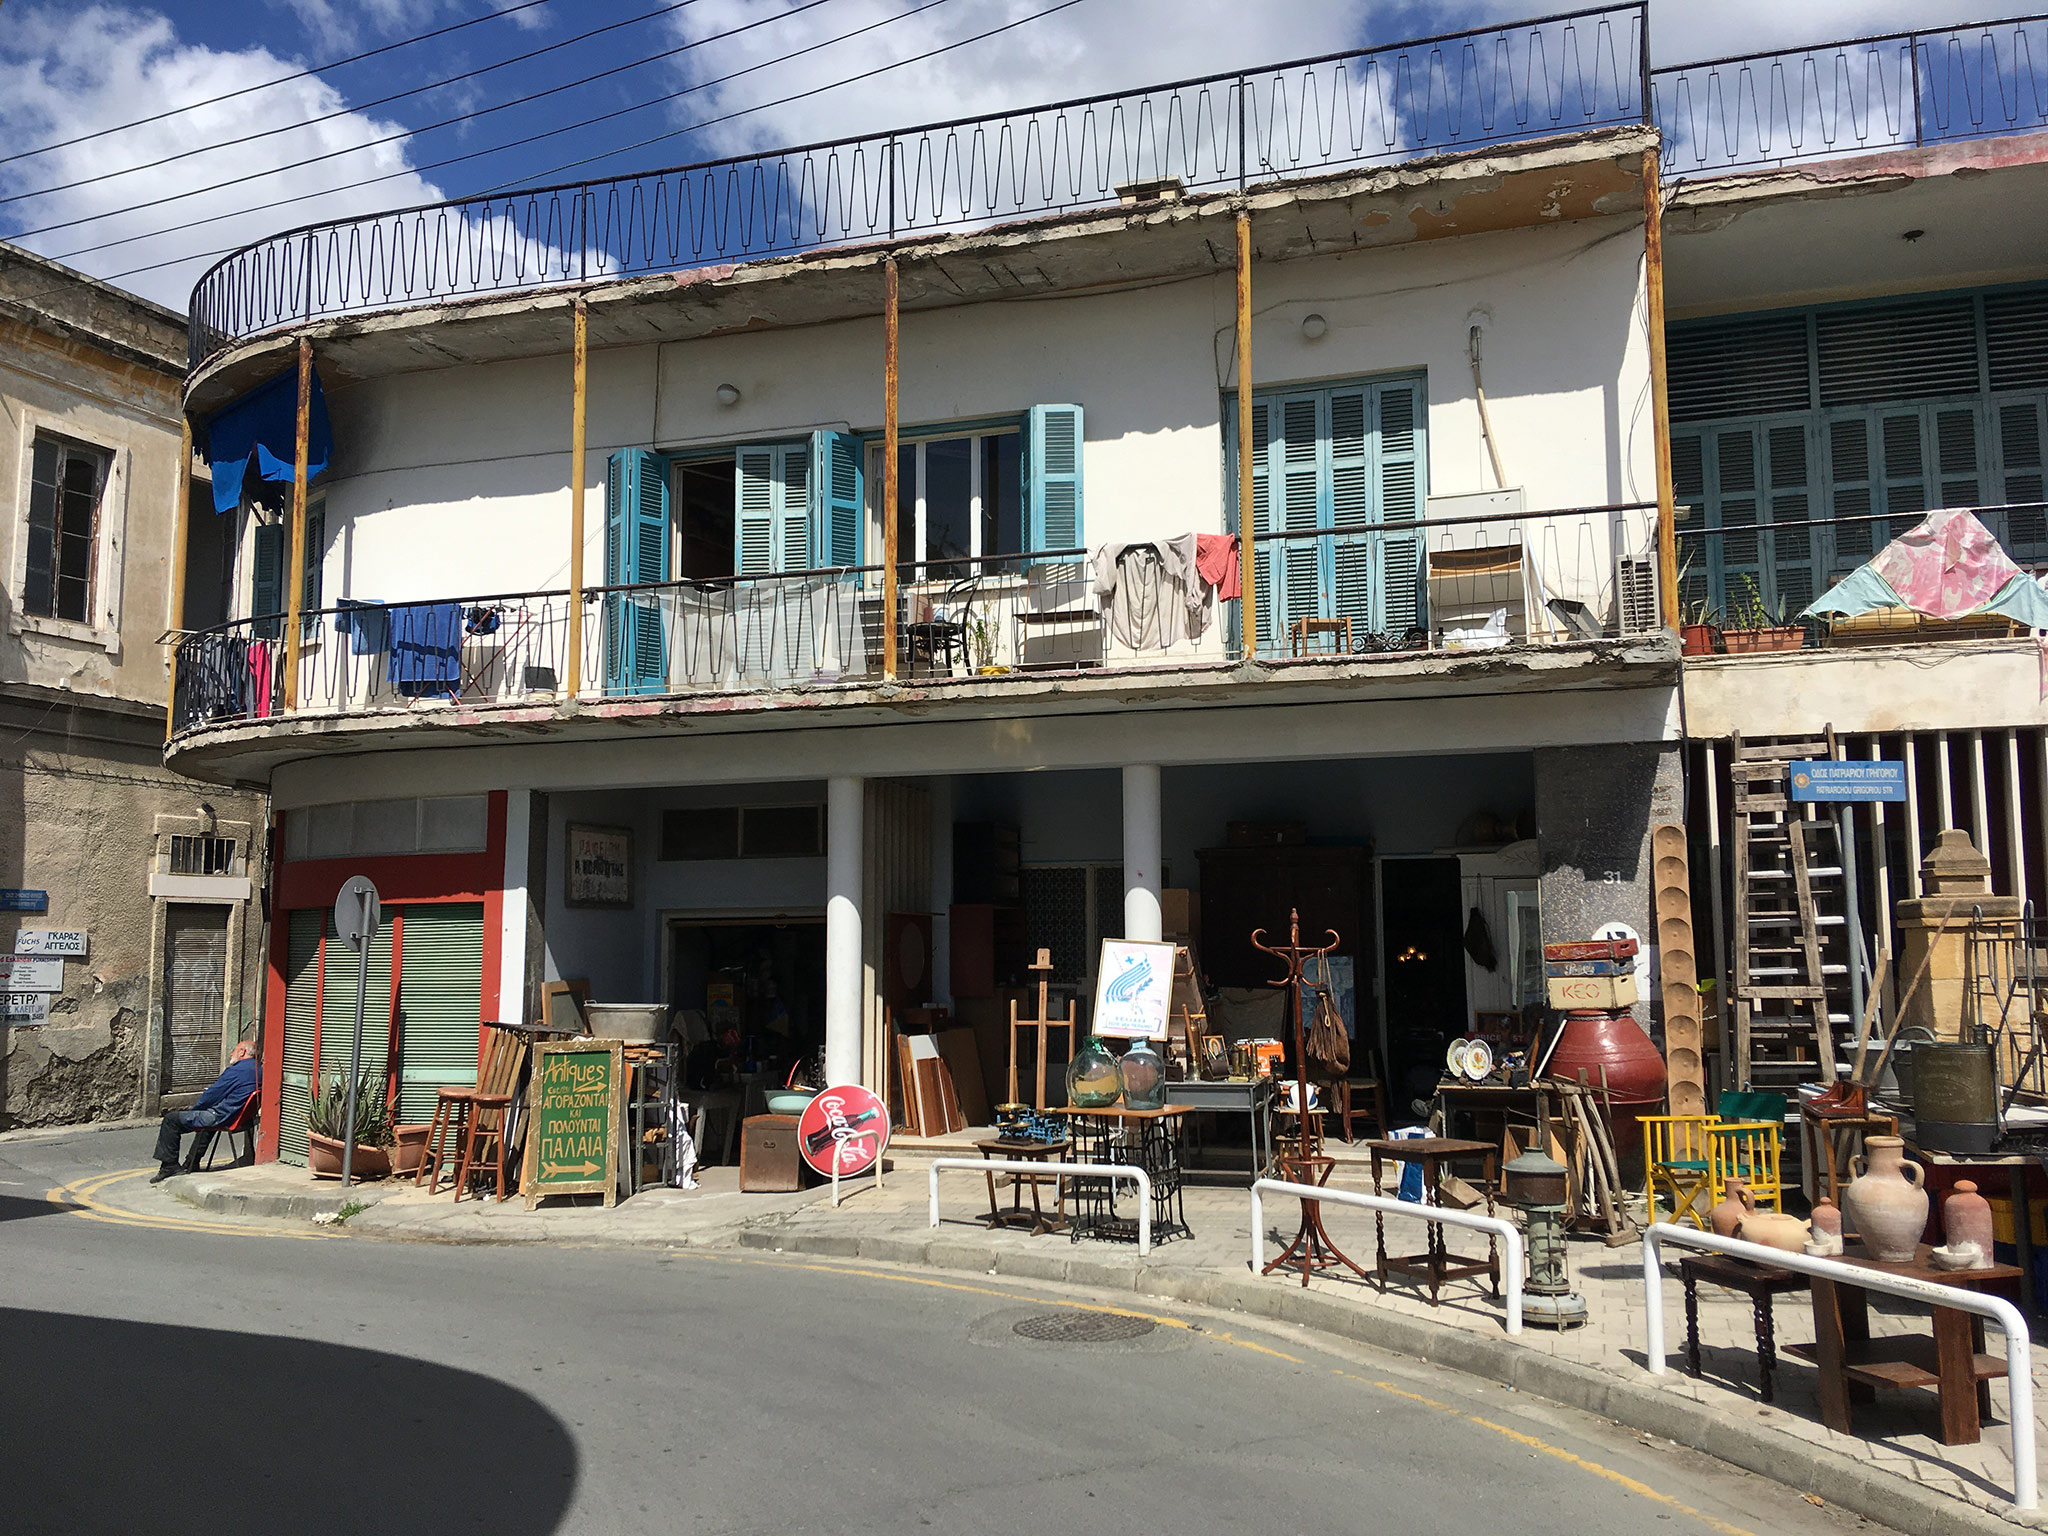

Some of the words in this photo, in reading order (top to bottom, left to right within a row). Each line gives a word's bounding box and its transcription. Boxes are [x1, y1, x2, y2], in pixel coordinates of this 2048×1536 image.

[1829, 768, 1865, 778] ΠΑΤΡΙΑΡΧΟΥ
[1865, 768, 1898, 778] ΓΡΗΓΟΡΙΟΥ
[1816, 786, 1852, 794] PATRIARCHOU
[1852, 786, 1881, 794] GRIGORIOU
[1603, 870, 1621, 884] 31
[48, 932, 79, 941] ΓΚΑΡΑΖ
[44, 942, 80, 951] ΑΓΓΕΛΟΣ
[1562, 983, 1600, 999] KEO
[544, 1055, 606, 1091] Antiques
[543, 1093, 608, 1109] ΑΓΟΡΑΖΟΝΤΑΙ
[569, 1109, 581, 1118] ΚΑΙ
[548, 1118, 601, 1135] ΠΟΛΟΥΝΤΑΙ
[541, 1136, 603, 1160] ΠΑΛΑΙΑ
